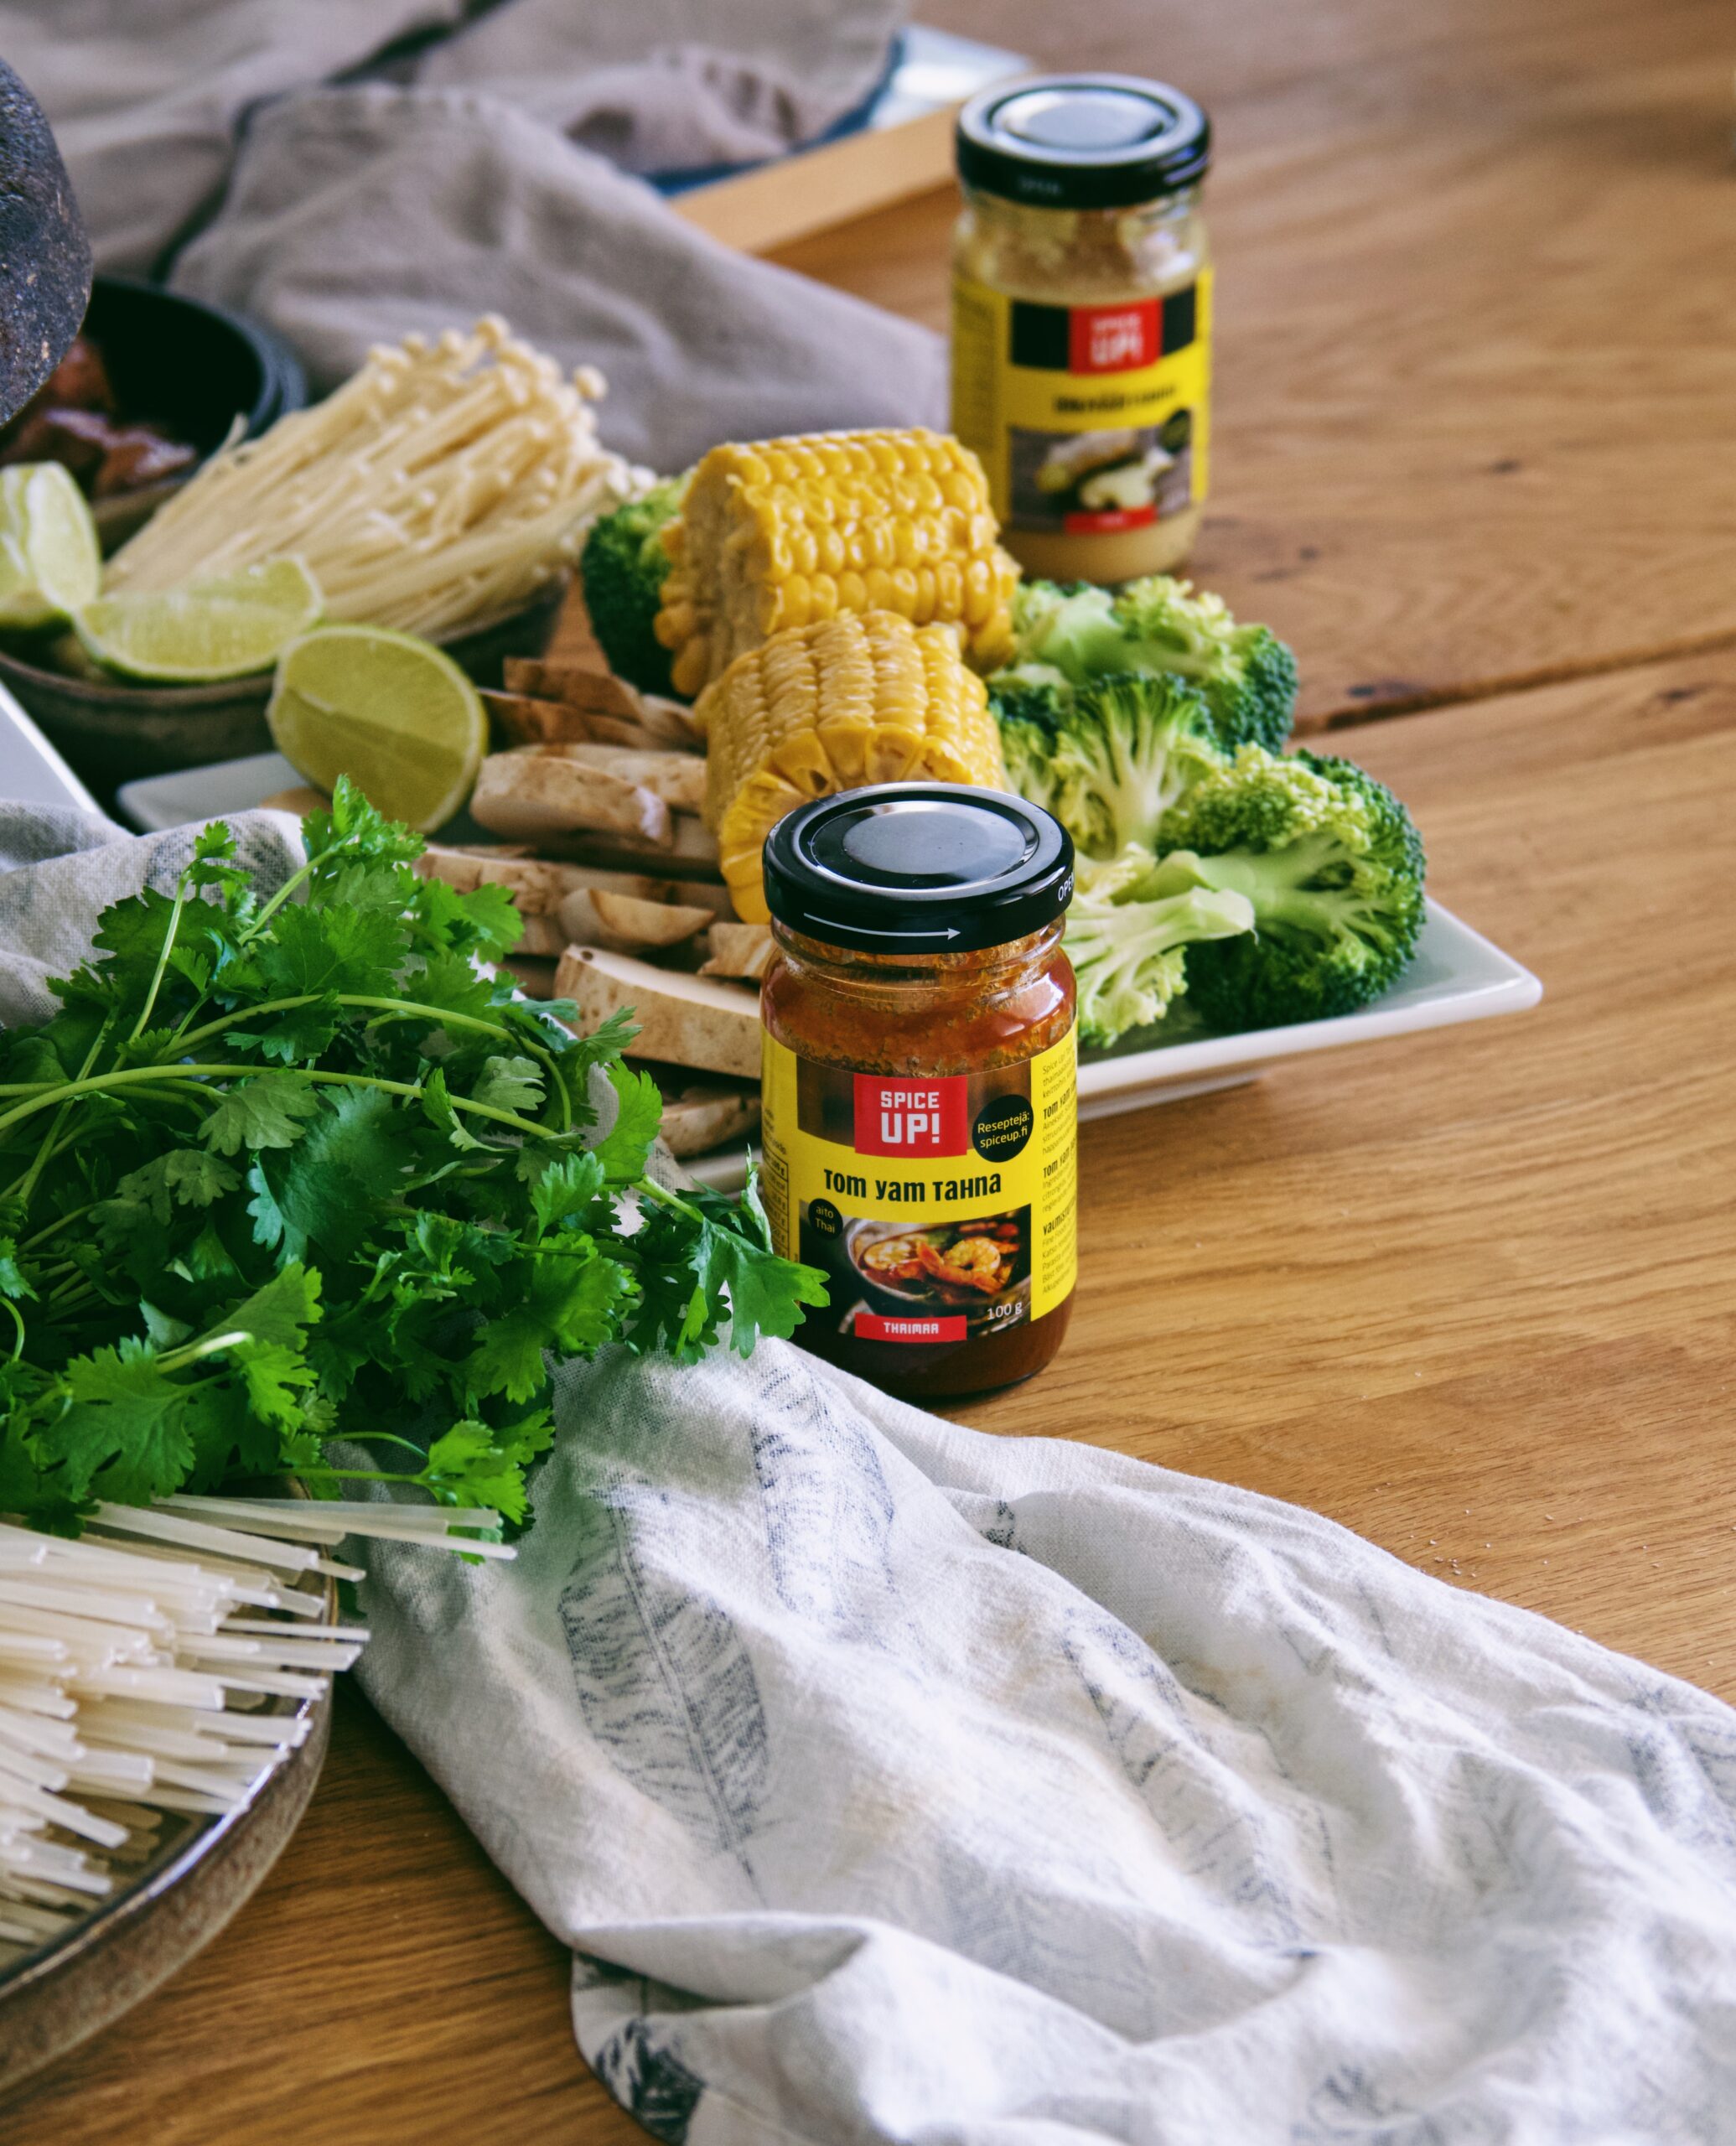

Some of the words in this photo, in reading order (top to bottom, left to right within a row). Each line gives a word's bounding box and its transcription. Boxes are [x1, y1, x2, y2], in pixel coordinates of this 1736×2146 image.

[880, 1091, 940, 1109] SPICE
[881, 1112, 940, 1144] UP!
[977, 1112, 1031, 1134] Reseptejä:
[979, 1126, 1029, 1149] spiceup.fi
[875, 1179, 925, 1202] yam
[816, 1205, 834, 1220] aito
[815, 1217, 836, 1235] Thai
[987, 1303, 1013, 1321] 100
[1013, 1301, 1023, 1314] g
[884, 1321, 940, 1335] THAIMAA
